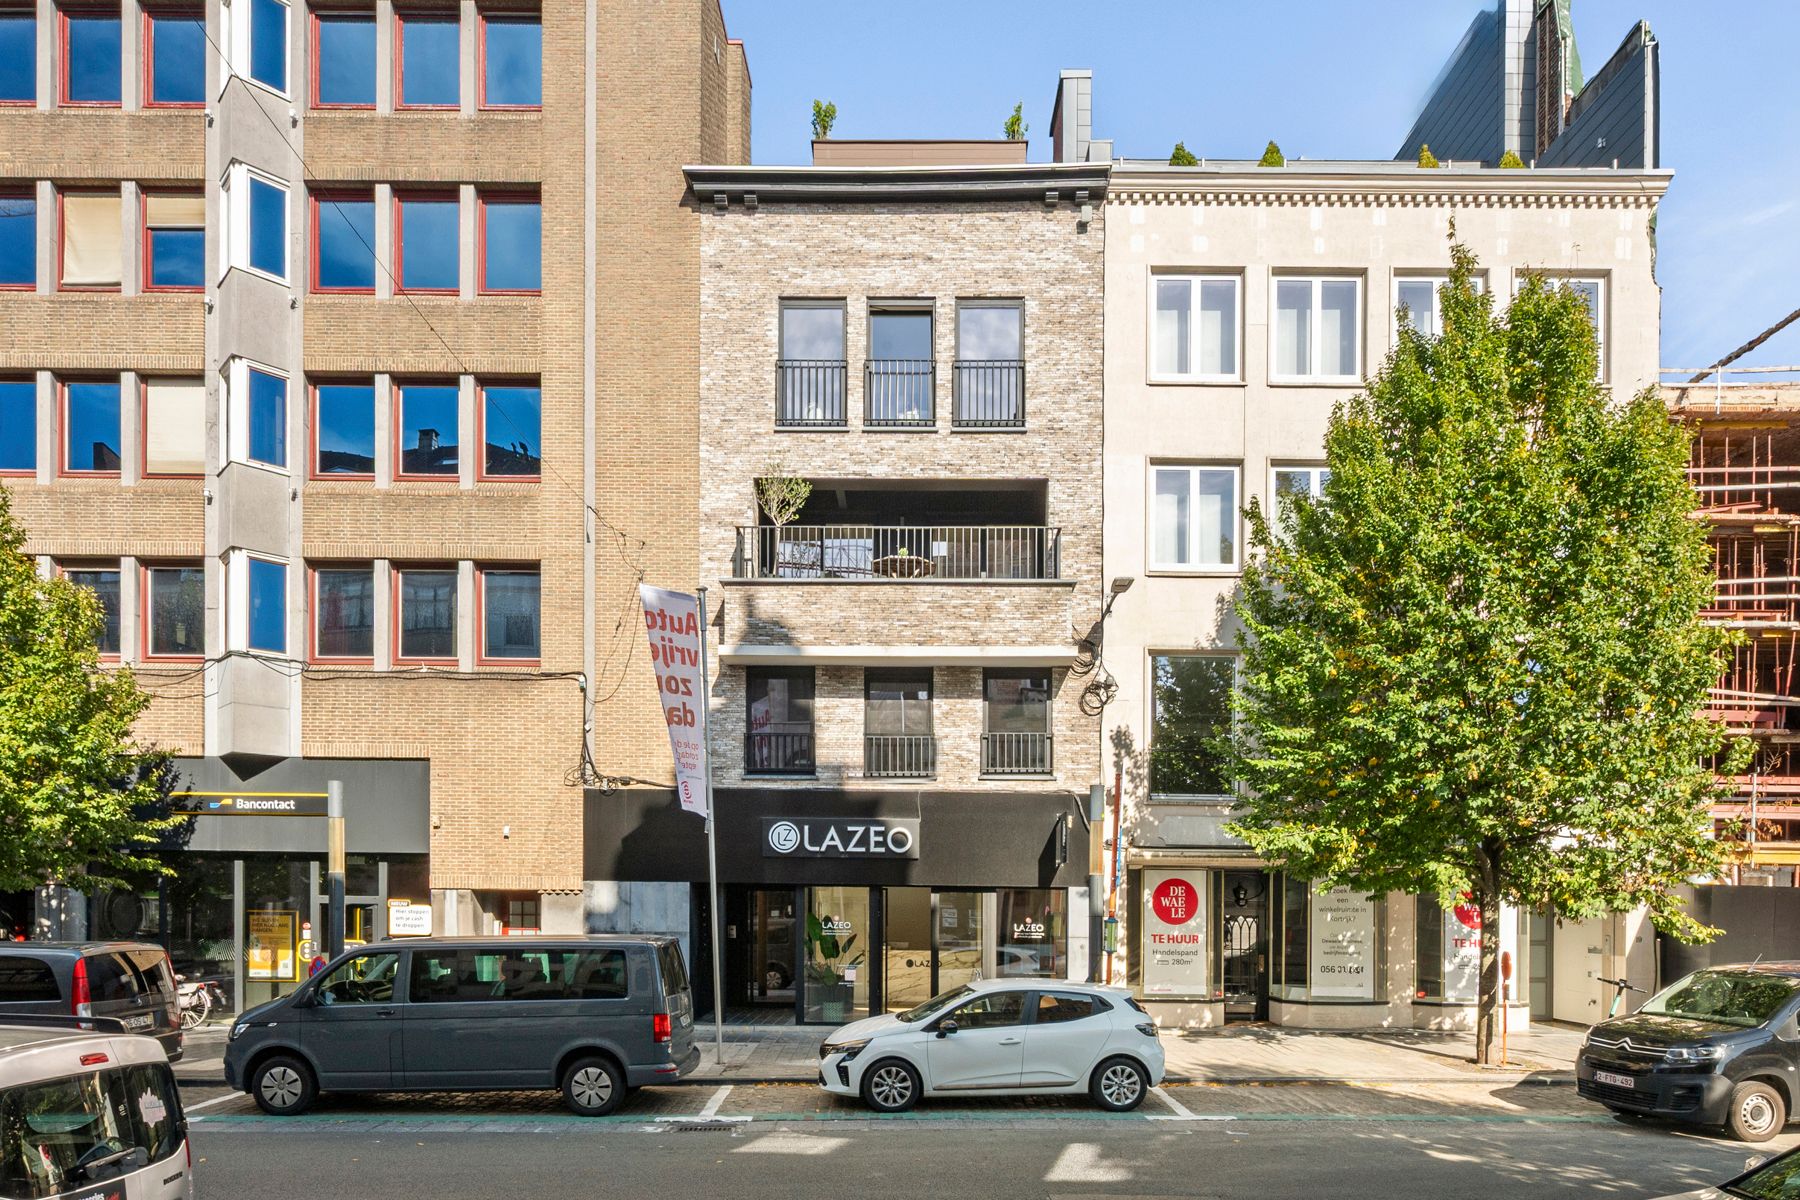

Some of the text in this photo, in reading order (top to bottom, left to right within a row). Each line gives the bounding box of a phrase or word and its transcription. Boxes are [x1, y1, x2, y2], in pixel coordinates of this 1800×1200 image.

[236, 798, 296, 810] Bancontact
[803, 824, 913, 854] LAZEO
[1170, 886, 1186, 896] DE
[1160, 896, 1186, 908] WAE
[1171, 908, 1186, 918] LE
[822, 921, 852, 930] LAZEO
[1014, 923, 1044, 932] LAZEO
[1151, 934, 1199, 944] TE HUUR
[1452, 938, 1466, 948] TE
[1152, 948, 1198, 957] Handelspand
[914, 960, 942, 968] LAZO
[1320, 965, 1336, 974] 056
[1598, 1072, 1633, 1087] 2-FTG-492
